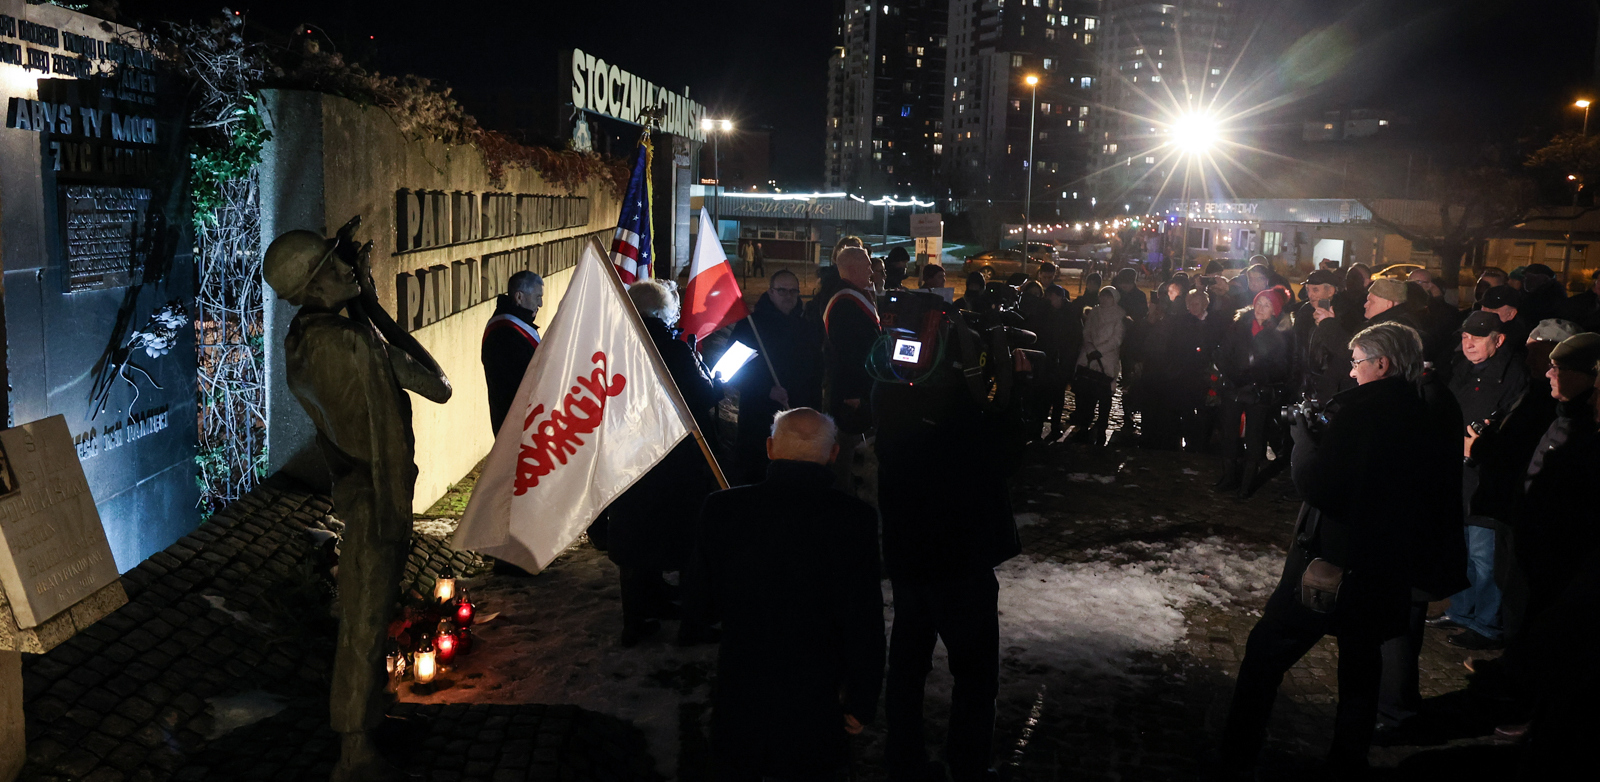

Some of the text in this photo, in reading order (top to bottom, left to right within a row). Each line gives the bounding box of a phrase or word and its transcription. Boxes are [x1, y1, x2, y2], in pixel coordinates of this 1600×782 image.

[79, 106, 104, 139] TY
[571, 47, 708, 144] STOCZNIA GDAŃSKA
[402, 190, 452, 252] PAN
[456, 191, 482, 243] DA
[402, 265, 452, 333] PAN
[456, 259, 482, 313] DA
